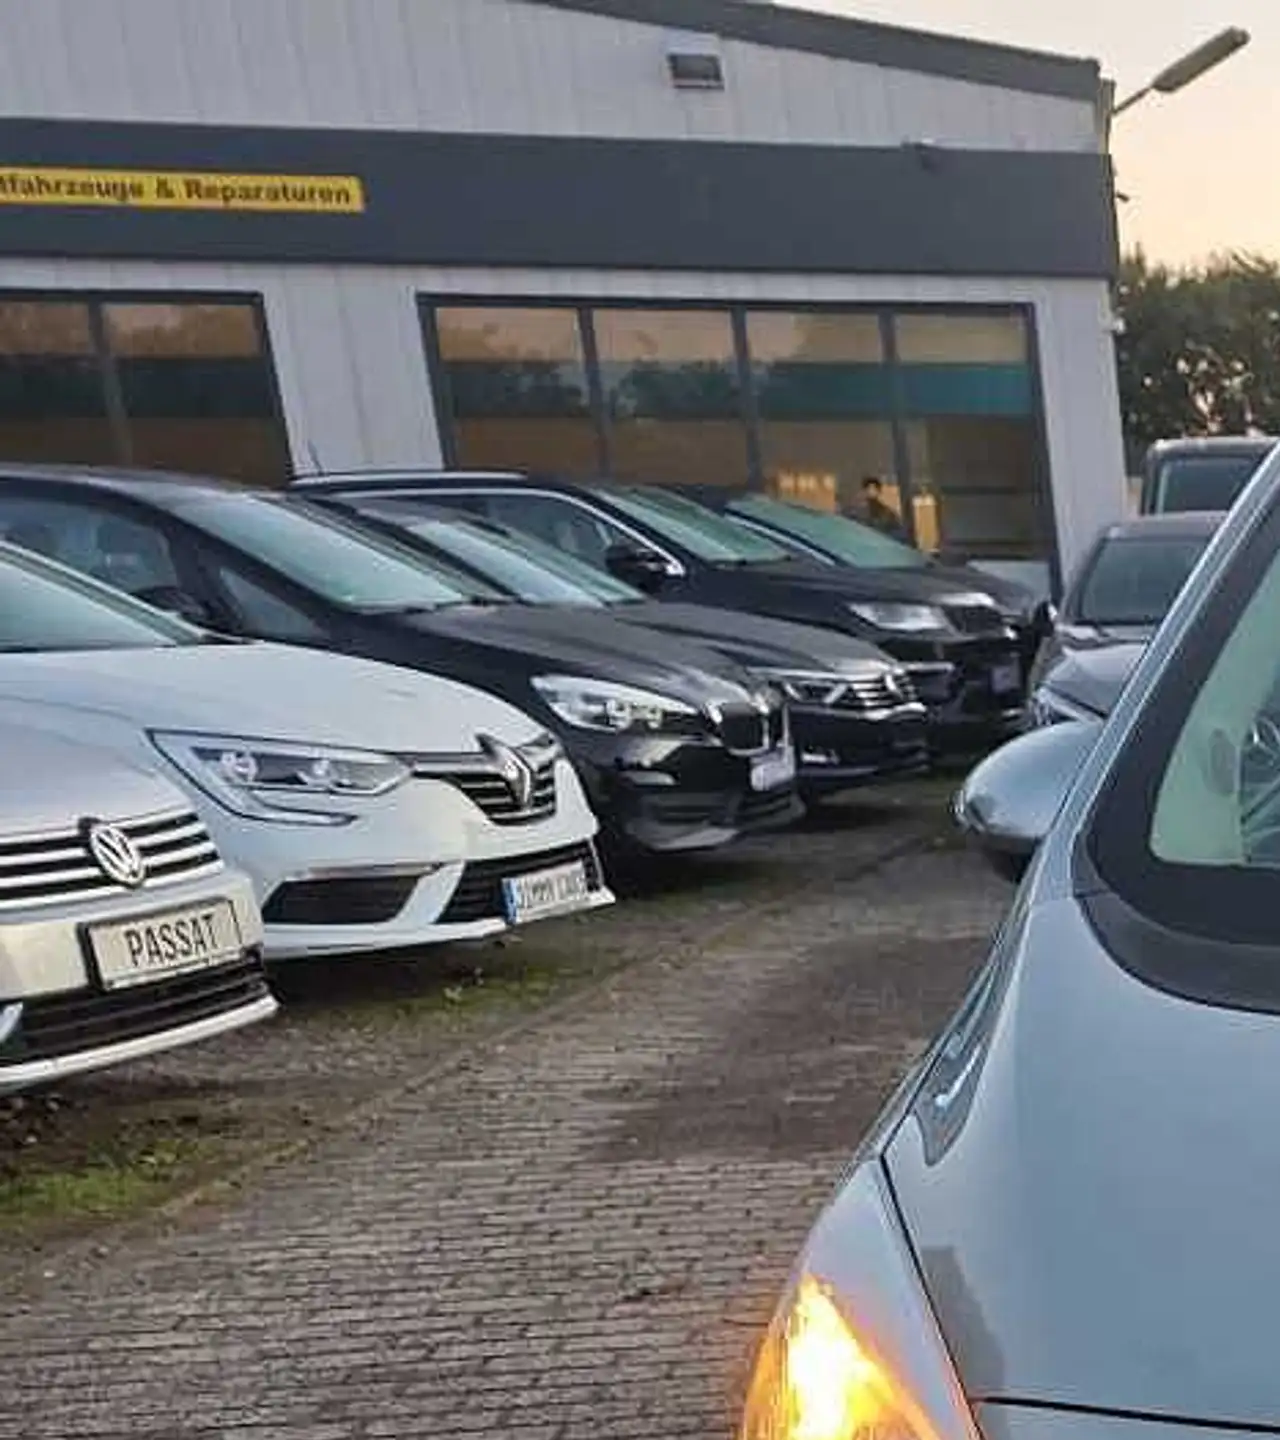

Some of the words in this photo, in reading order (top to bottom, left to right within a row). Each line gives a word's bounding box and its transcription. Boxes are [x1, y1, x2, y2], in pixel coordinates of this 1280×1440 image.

[155, 177, 174, 199] &
[186, 178, 350, 205] Reparaturen
[124, 913, 218, 967] PASSAT
